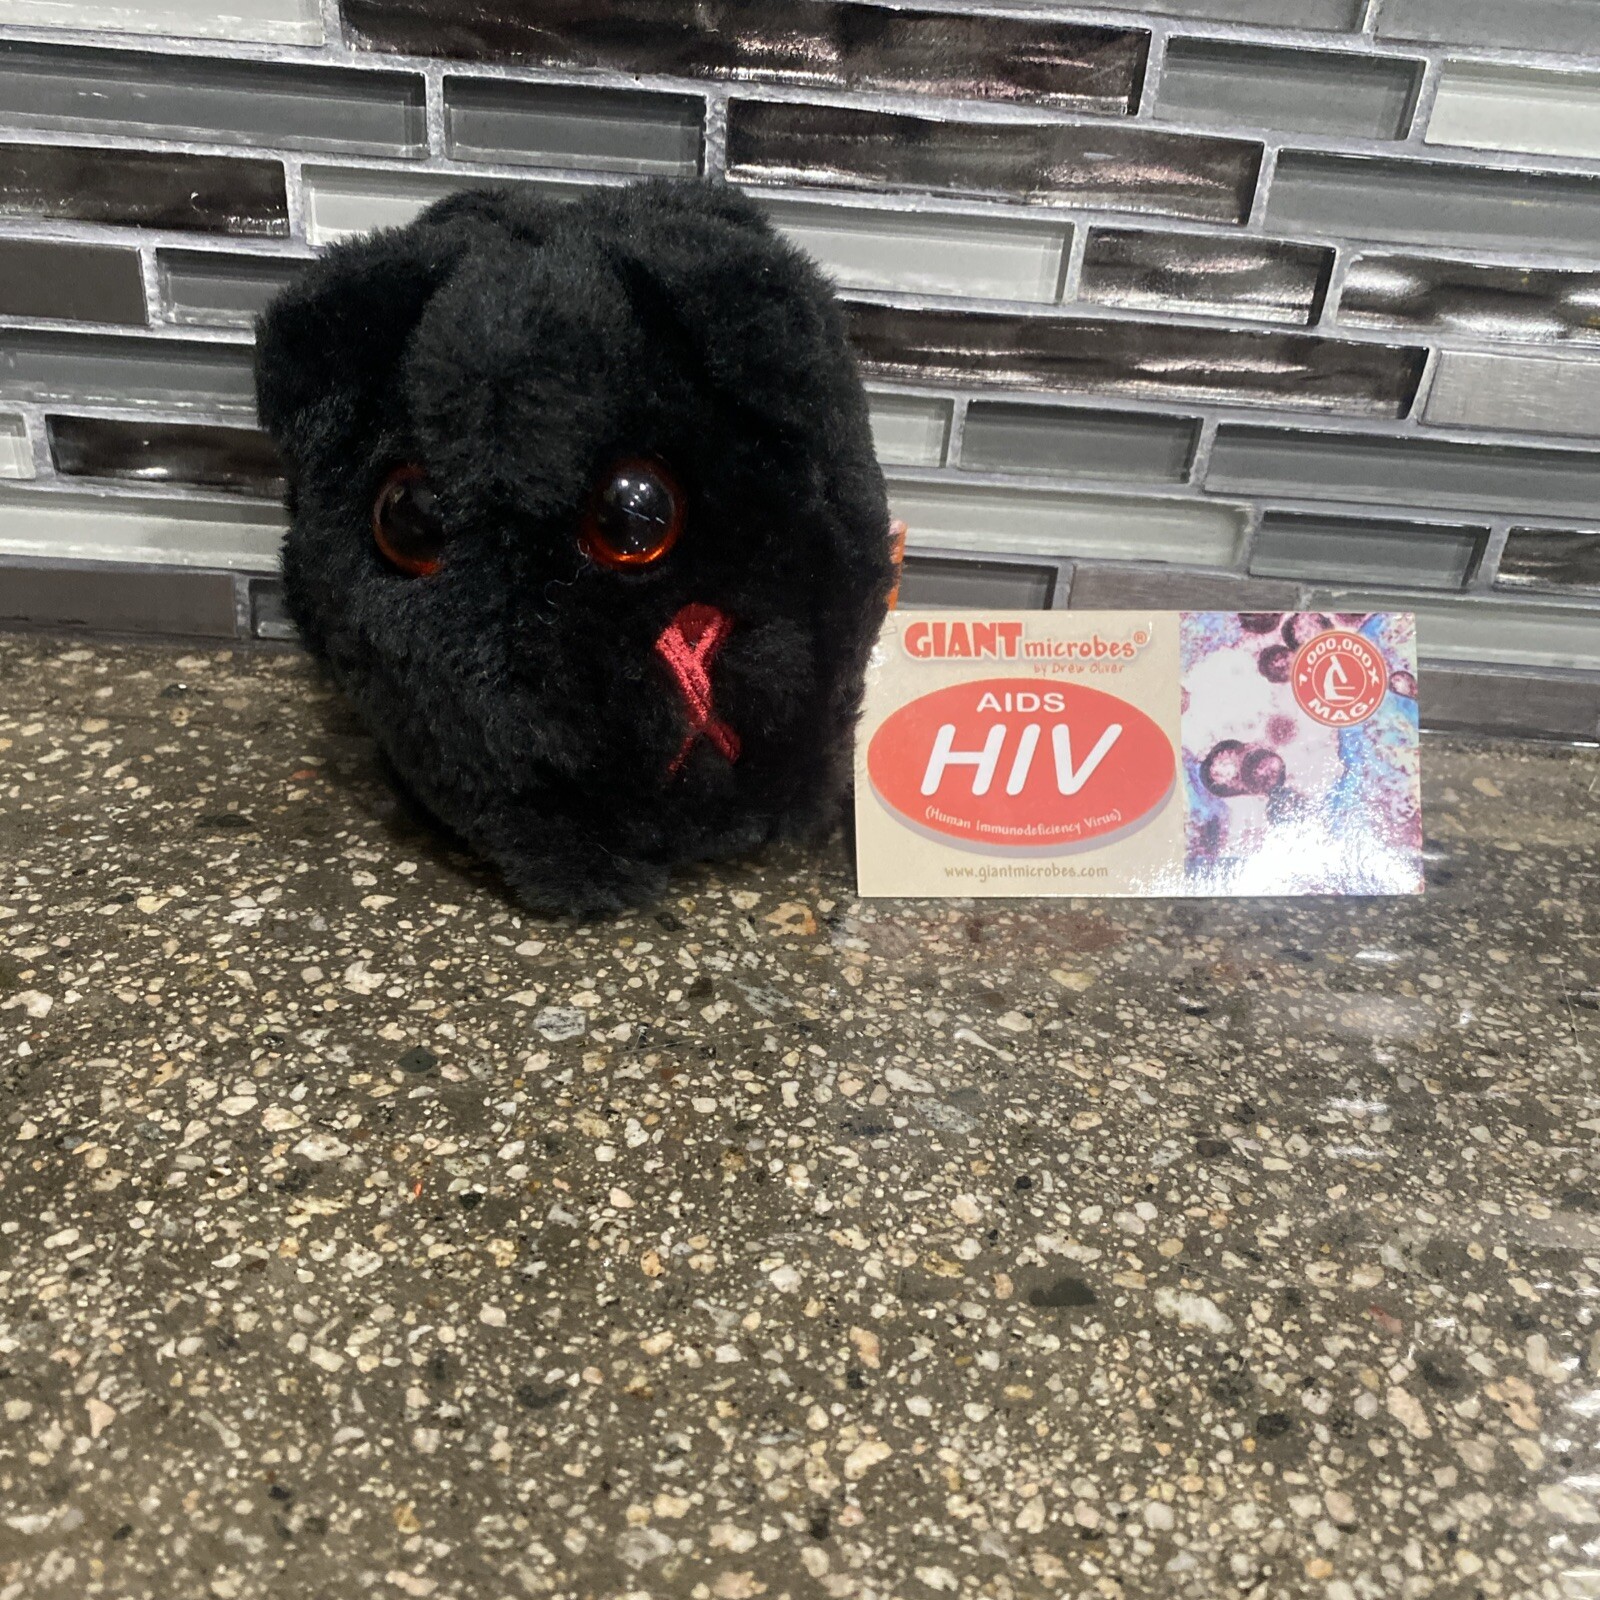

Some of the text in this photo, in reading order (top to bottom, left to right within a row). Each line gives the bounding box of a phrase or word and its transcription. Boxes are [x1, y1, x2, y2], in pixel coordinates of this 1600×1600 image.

[904, 621, 1023, 659] GIANT
[1034, 661, 1048, 677] by
[1052, 662, 1085, 674] Drew
[976, 692, 1066, 712] AIDS
[920, 723, 1123, 796] HIV
[925, 805, 1122, 836] (Human Immunodeficiency Virus)
[944, 862, 1109, 884] www.giantmicrobes.com
